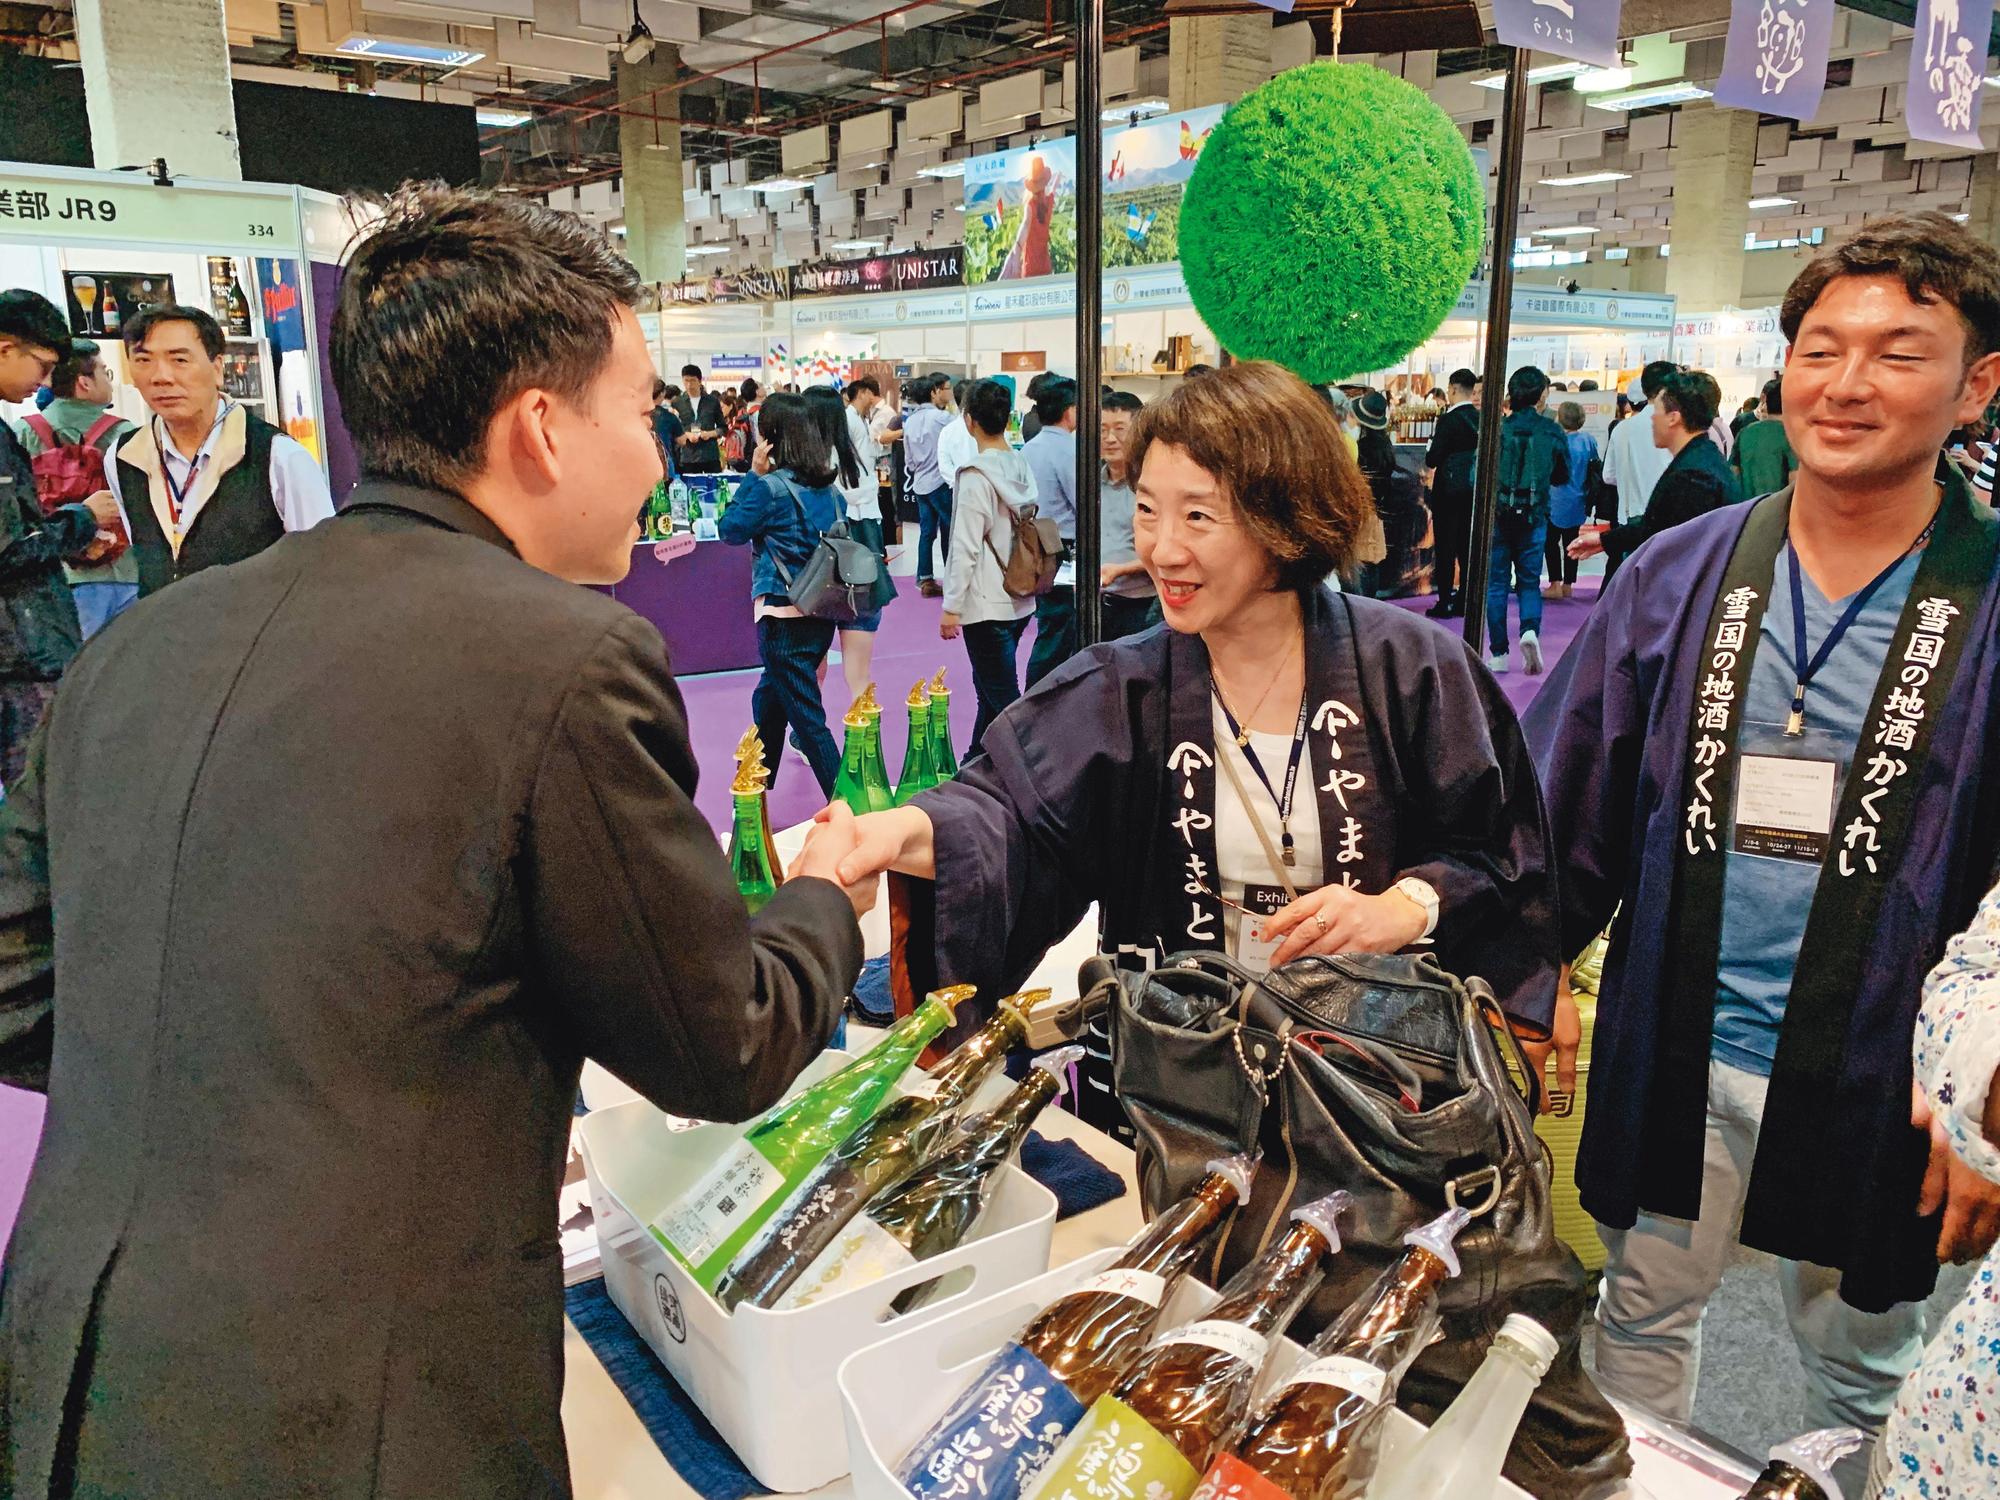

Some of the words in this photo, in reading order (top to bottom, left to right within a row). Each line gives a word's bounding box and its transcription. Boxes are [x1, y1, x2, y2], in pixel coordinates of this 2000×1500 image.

[59, 198, 116, 222] JR9
[248, 224, 274, 237] 334
[897, 259, 959, 280] UNISTAR
[1685, 586, 1760, 856] 雪国の地酒かくれい
[1838, 597, 1961, 877] 雪国の地酒かくれい
[1050, 1420, 1145, 1500] 鶴
